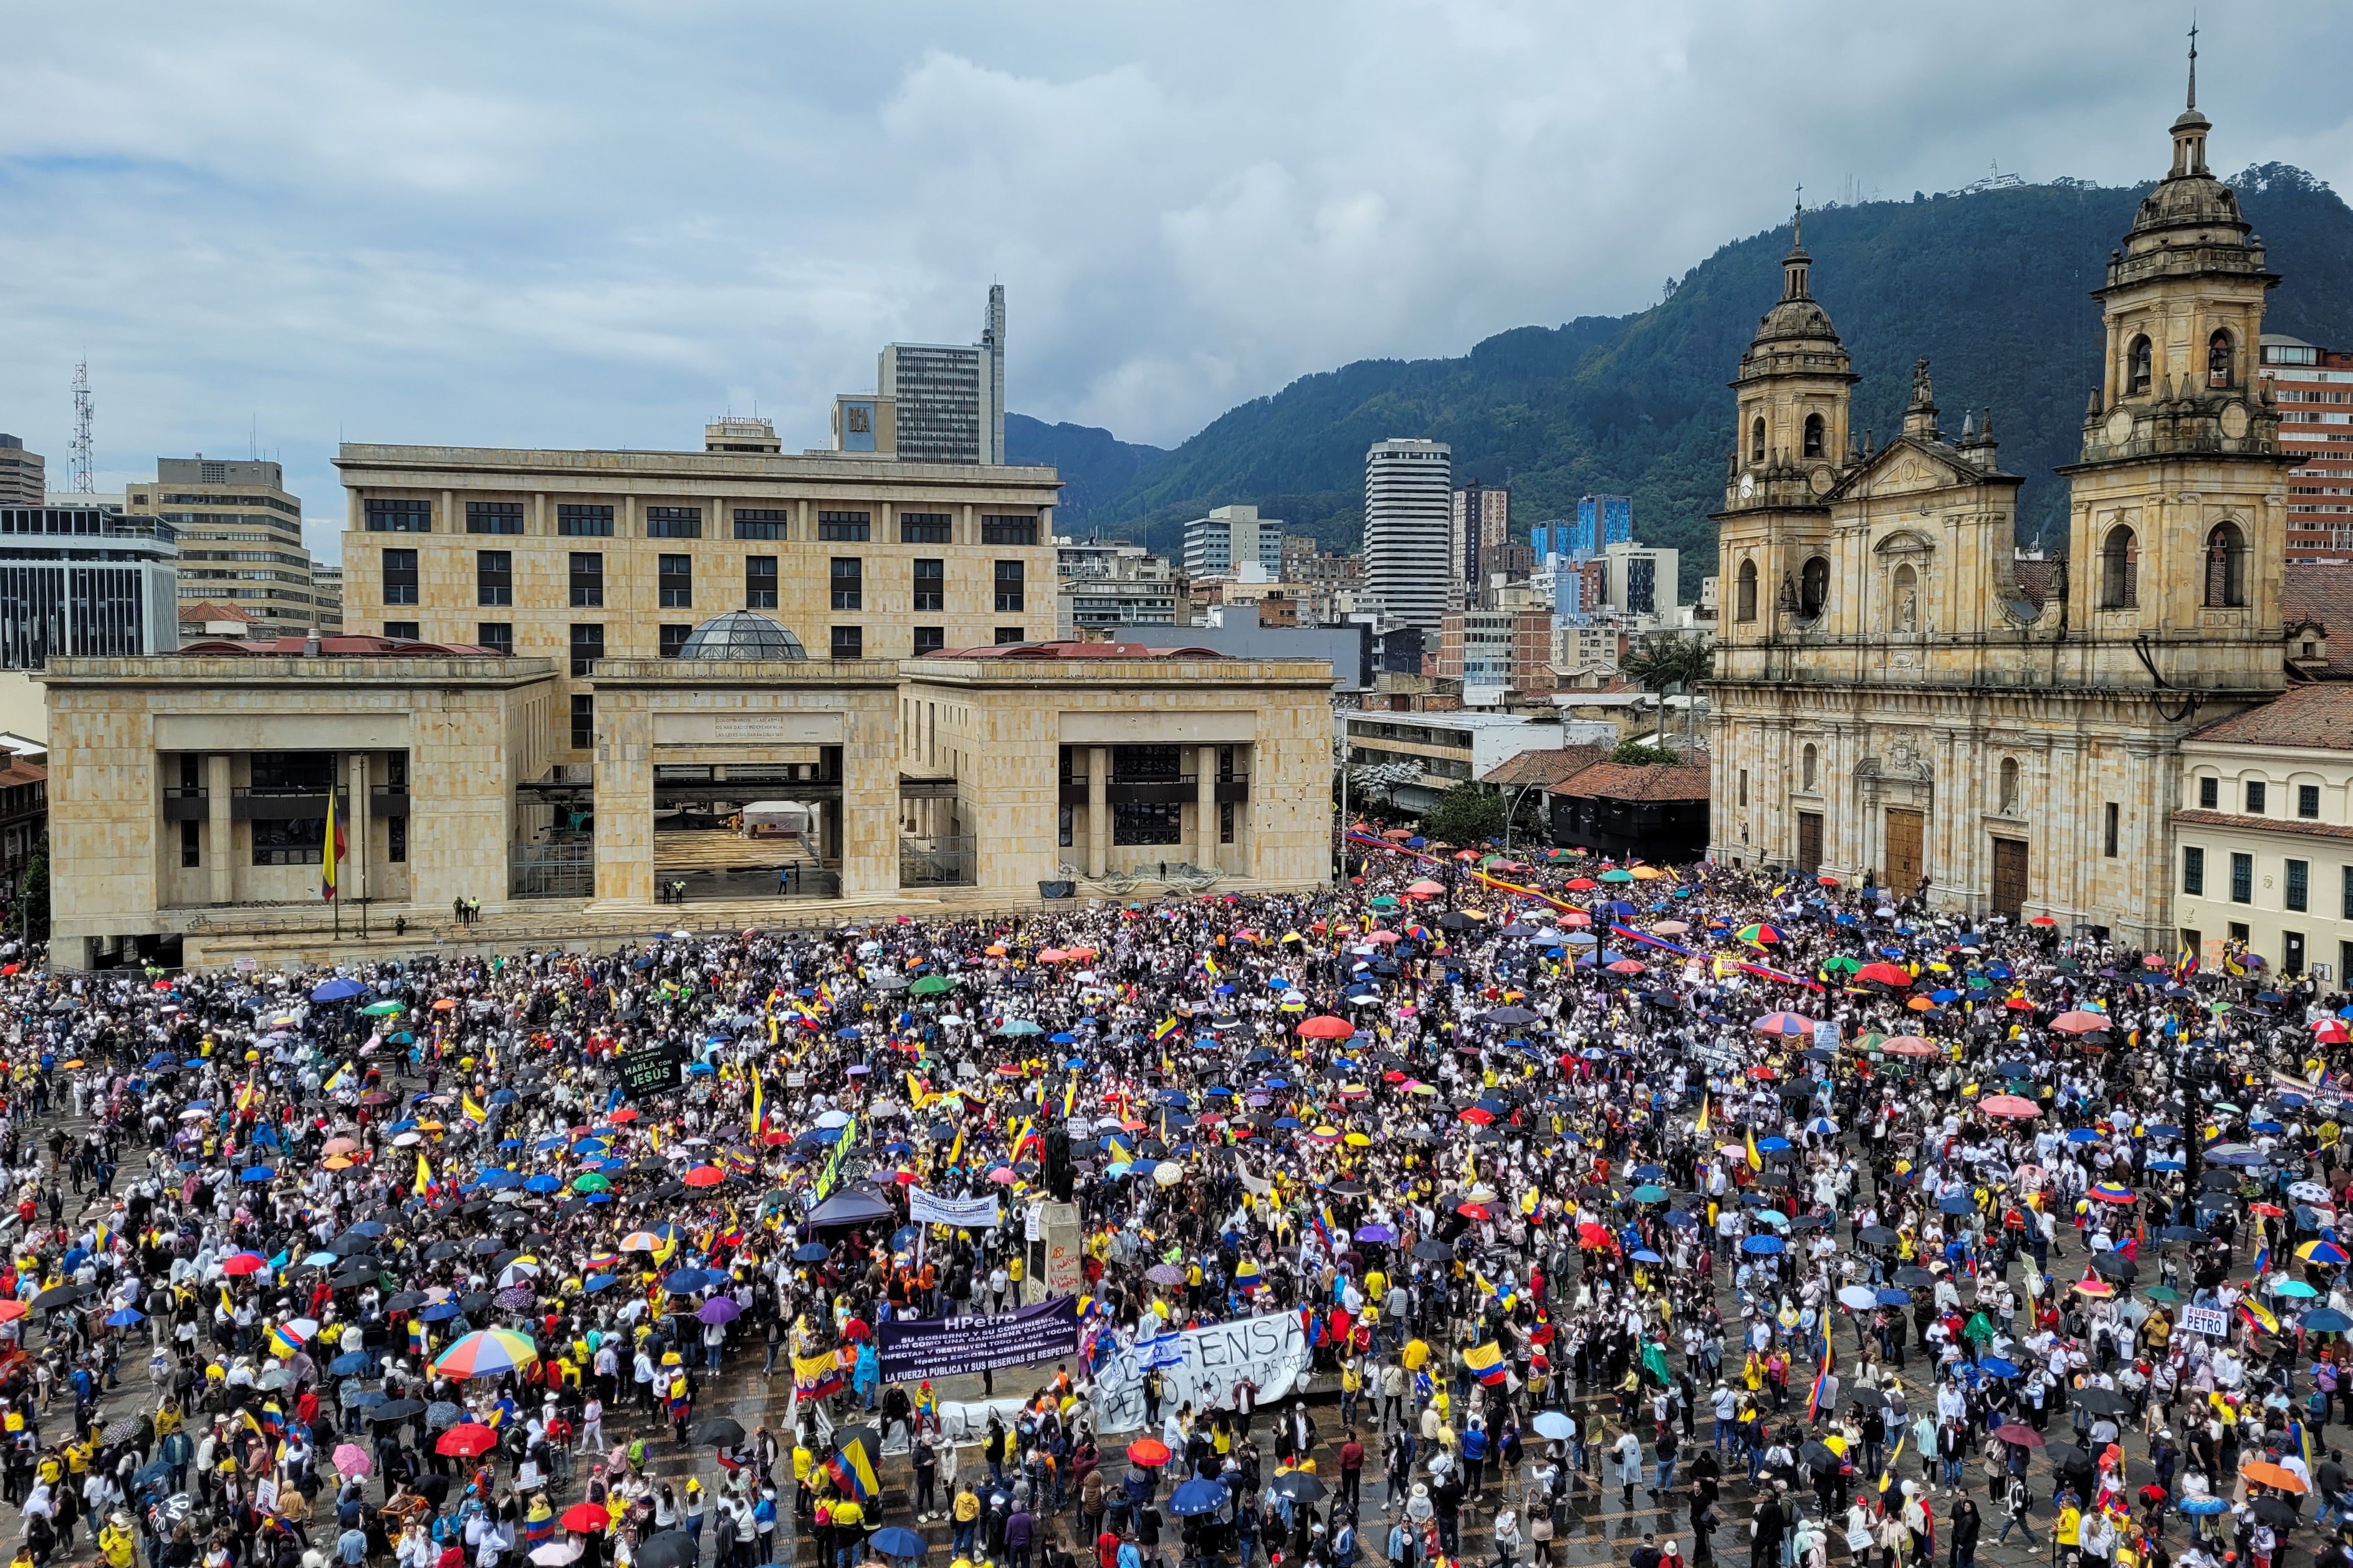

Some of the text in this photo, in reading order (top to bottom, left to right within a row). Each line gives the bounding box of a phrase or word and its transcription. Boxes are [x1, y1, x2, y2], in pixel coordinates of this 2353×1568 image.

[848, 408, 870, 432] BCA
[624, 1061, 655, 1076] HABLA
[631, 1067, 670, 1087] JESÚS
[944, 1314, 1017, 1331] HPetro
[2187, 1315, 2221, 1333] PETRO
[2188, 1308, 2222, 1320] FUERA
[911, 1340, 941, 1349] COMO
[968, 1331, 1021, 1342] GANGRENA
[1024, 1320, 1069, 1333] GASEOSA.
[918, 1332, 969, 1342] GOBIERNO
[997, 1317, 1057, 1333] COMUNISMO,
[881, 1350, 924, 1361] INFECTAN
[936, 1342, 987, 1355] DESTRUYEN
[989, 1339, 1011, 1347] TODO
[1045, 1326, 1076, 1337] TOCAN.
[914, 1341, 1047, 1365] Hpetro ESCORIA CRIMINAL.
[885, 1344, 1074, 1383] LA FUERZA PÚBLICA Y SUS RESERVAS SE RESPETAN
